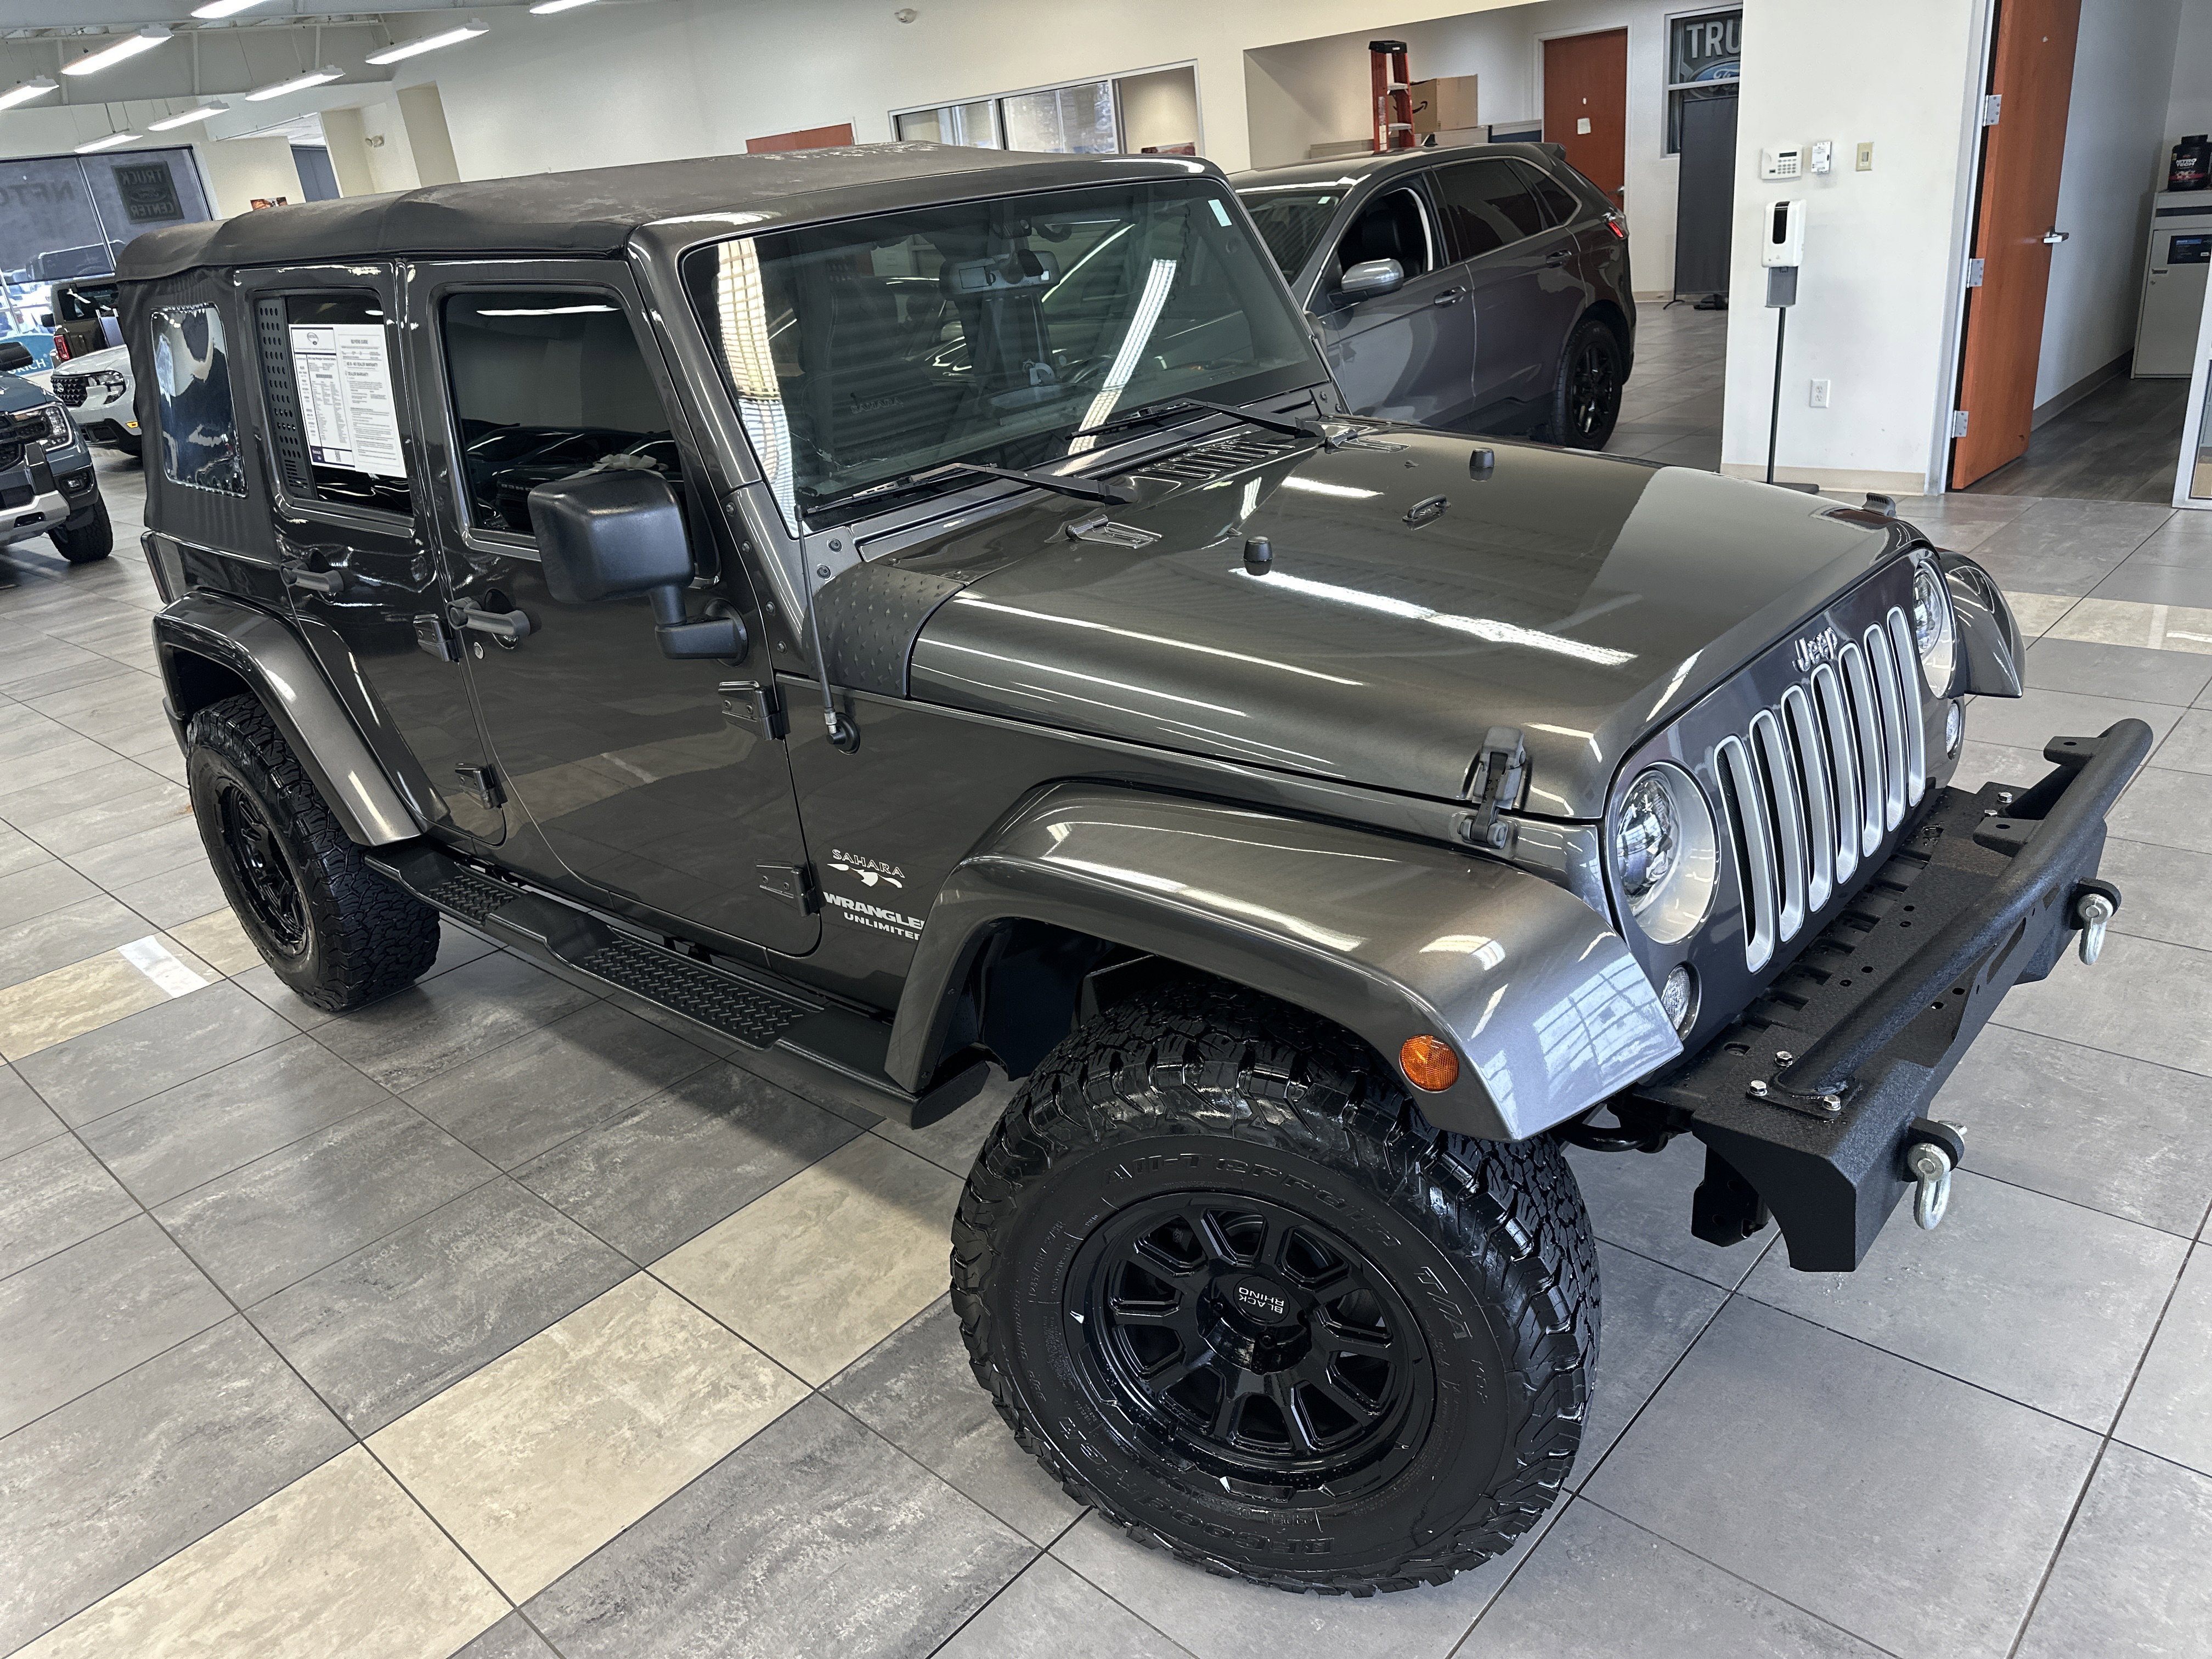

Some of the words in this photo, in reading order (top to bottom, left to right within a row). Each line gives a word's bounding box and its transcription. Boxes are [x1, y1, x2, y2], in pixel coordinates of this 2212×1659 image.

[1686, 19, 1742, 59] TRU
[1792, 627, 1837, 672] Jeep
[832, 849, 905, 878] SAHARA
[1239, 1286, 1284, 1307] RHINO
[1239, 1294, 1283, 1314] BLACK
